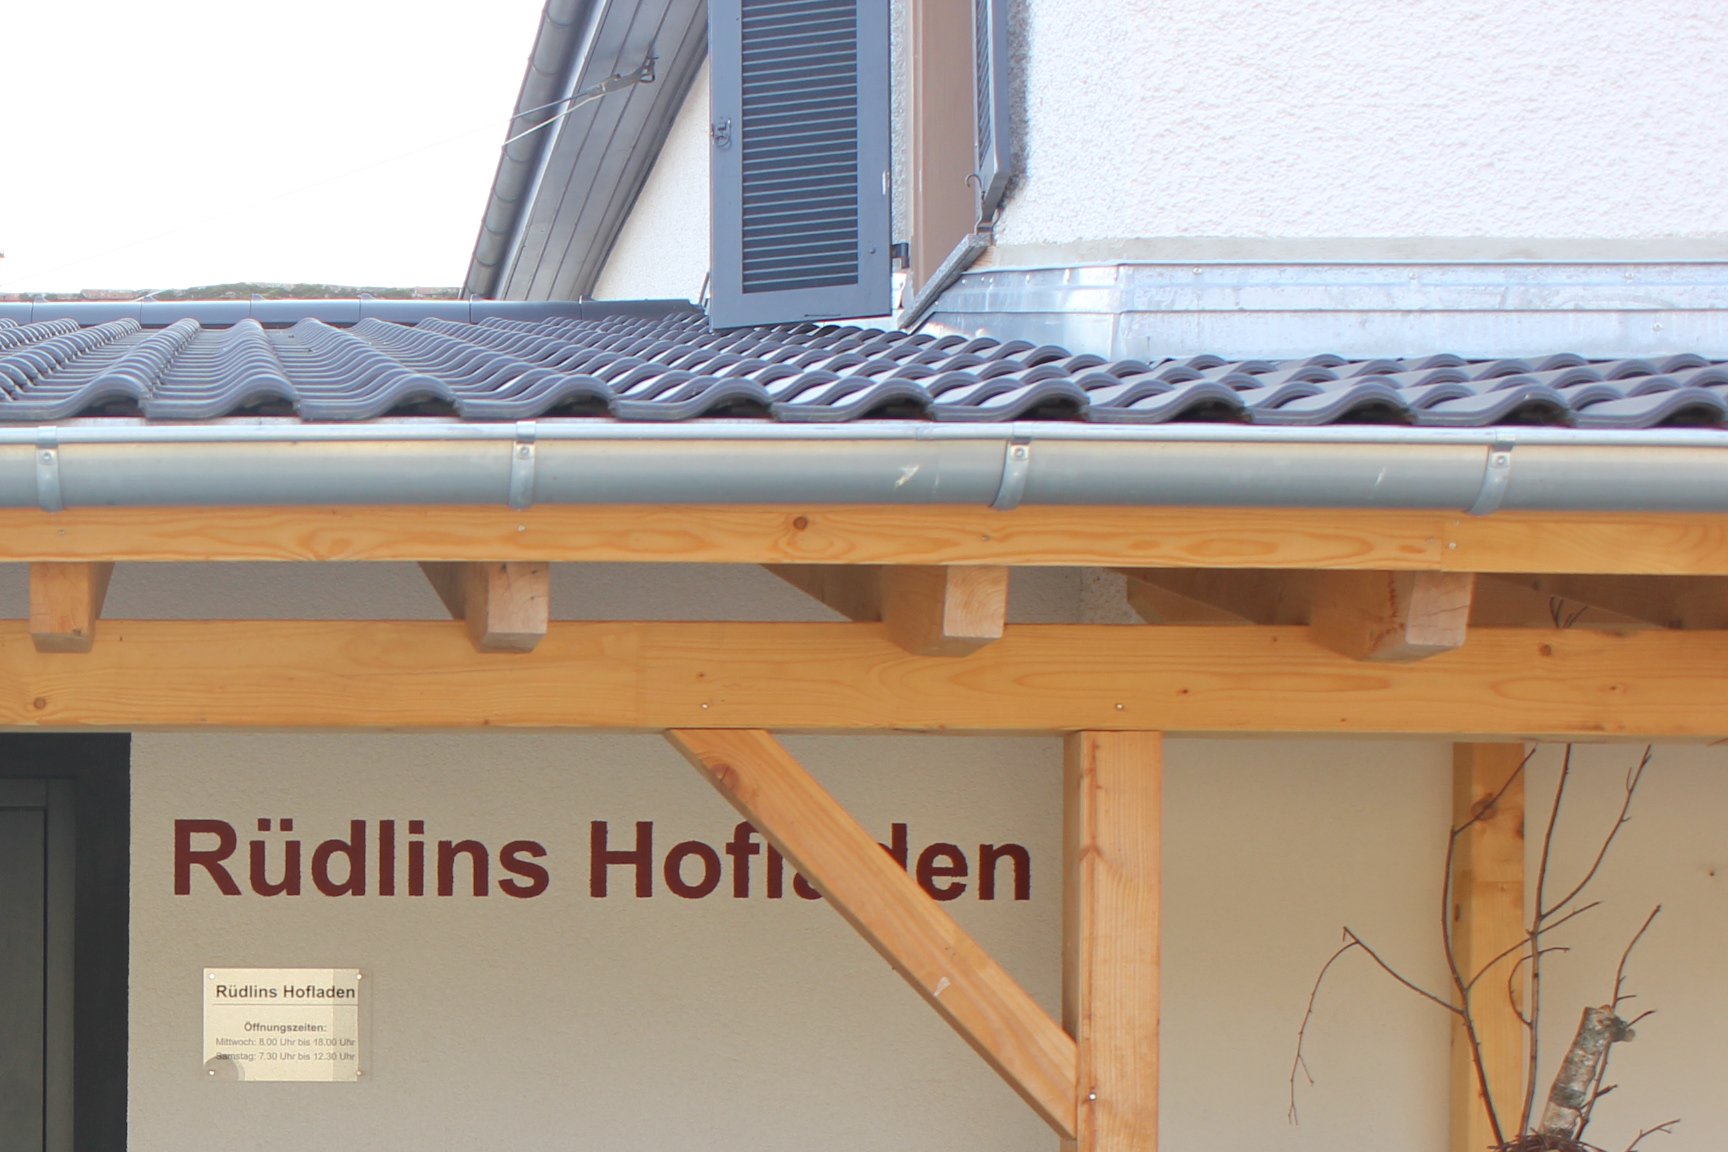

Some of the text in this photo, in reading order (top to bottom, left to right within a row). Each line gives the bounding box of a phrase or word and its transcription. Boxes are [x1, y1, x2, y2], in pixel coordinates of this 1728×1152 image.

[173, 818, 550, 898] Rüdlins
[216, 985, 355, 998] Rüdlins Hofladen
[244, 1021, 327, 1033] Öffnungszeiten:
[216, 1038, 256, 1047] Mittwoch:
[280, 1038, 295, 1047] Uhr
[298, 1038, 311, 1047] bis
[314, 1038, 337, 1047] 18.00
[340, 1038, 356, 1047] Uhr
[280, 1052, 295, 1061] Uhr
[298, 1052, 311, 1061] bis
[340, 1052, 356, 1061] Uhr
